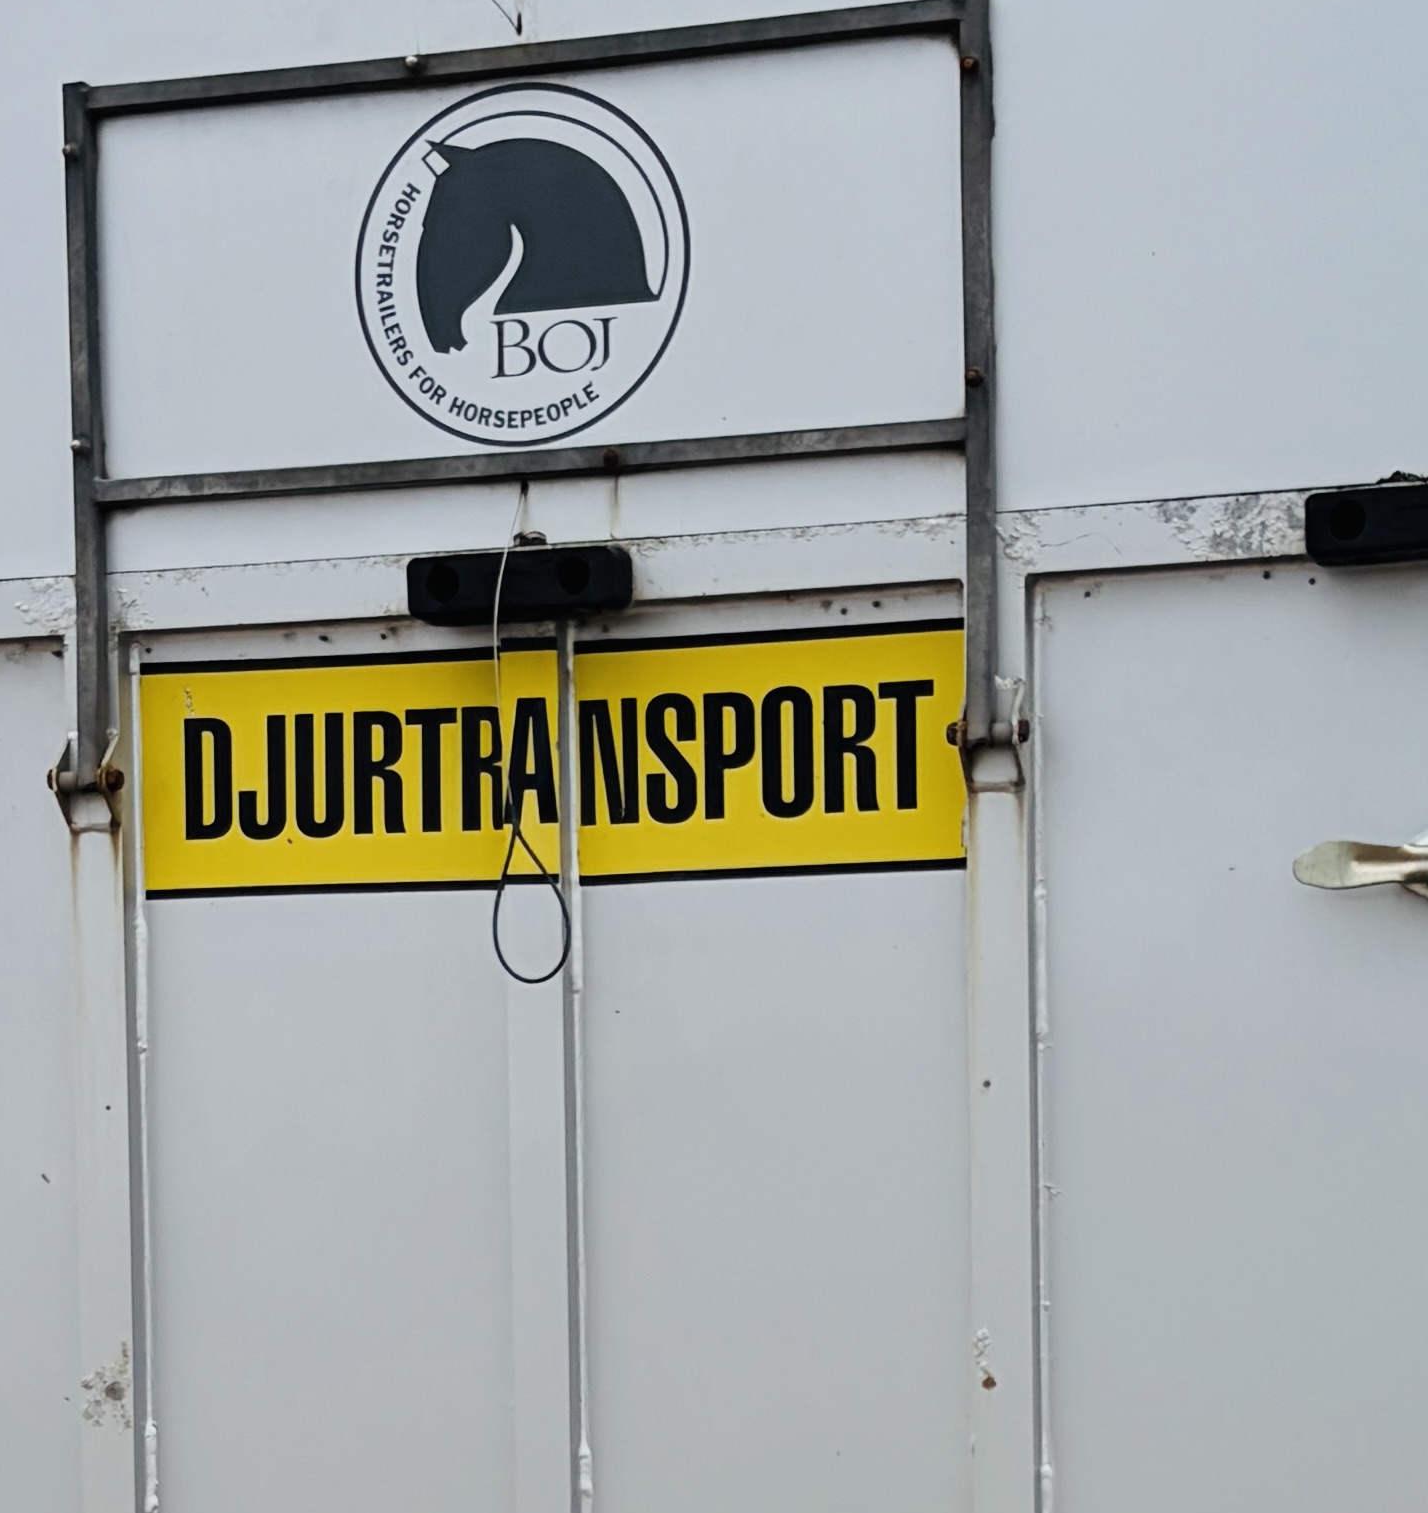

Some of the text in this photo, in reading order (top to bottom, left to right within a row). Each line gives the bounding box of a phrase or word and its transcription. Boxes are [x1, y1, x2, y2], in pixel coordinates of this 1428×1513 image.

[376, 182, 600, 429] HORSETRAILERS FOR HORSEPEOPLE
[489, 316, 619, 379] BOJ
[183, 678, 935, 841] DJURTRANSPORT
